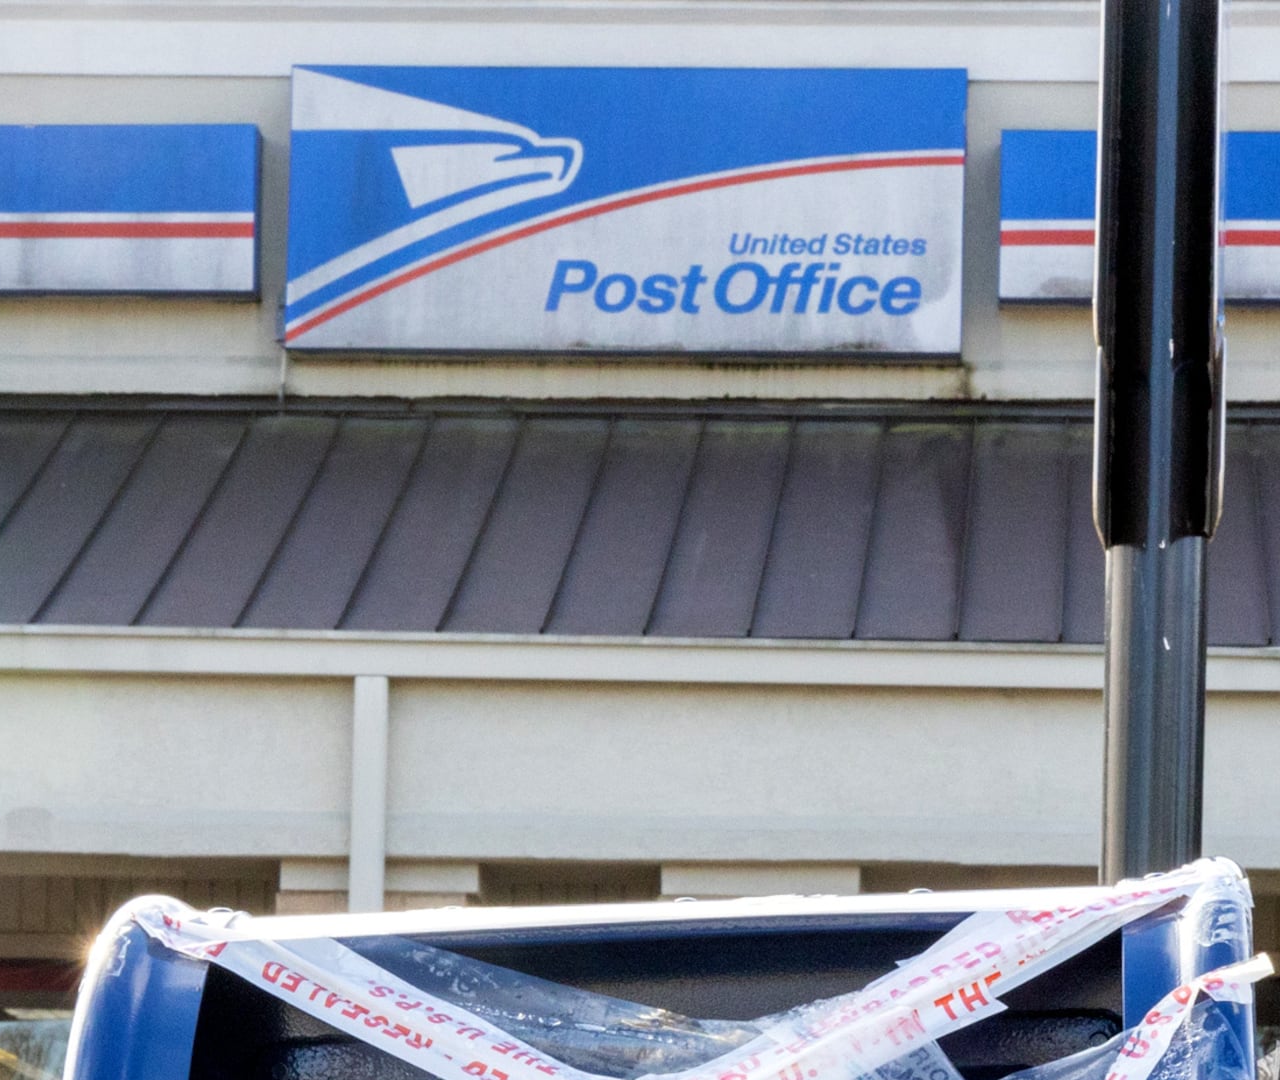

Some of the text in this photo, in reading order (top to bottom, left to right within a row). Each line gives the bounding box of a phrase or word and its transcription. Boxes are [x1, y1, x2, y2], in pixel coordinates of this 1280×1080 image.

[728, 233, 928, 256] United States
[544, 260, 923, 316] Post Office
[261, 960, 433, 1050] RESEALED
